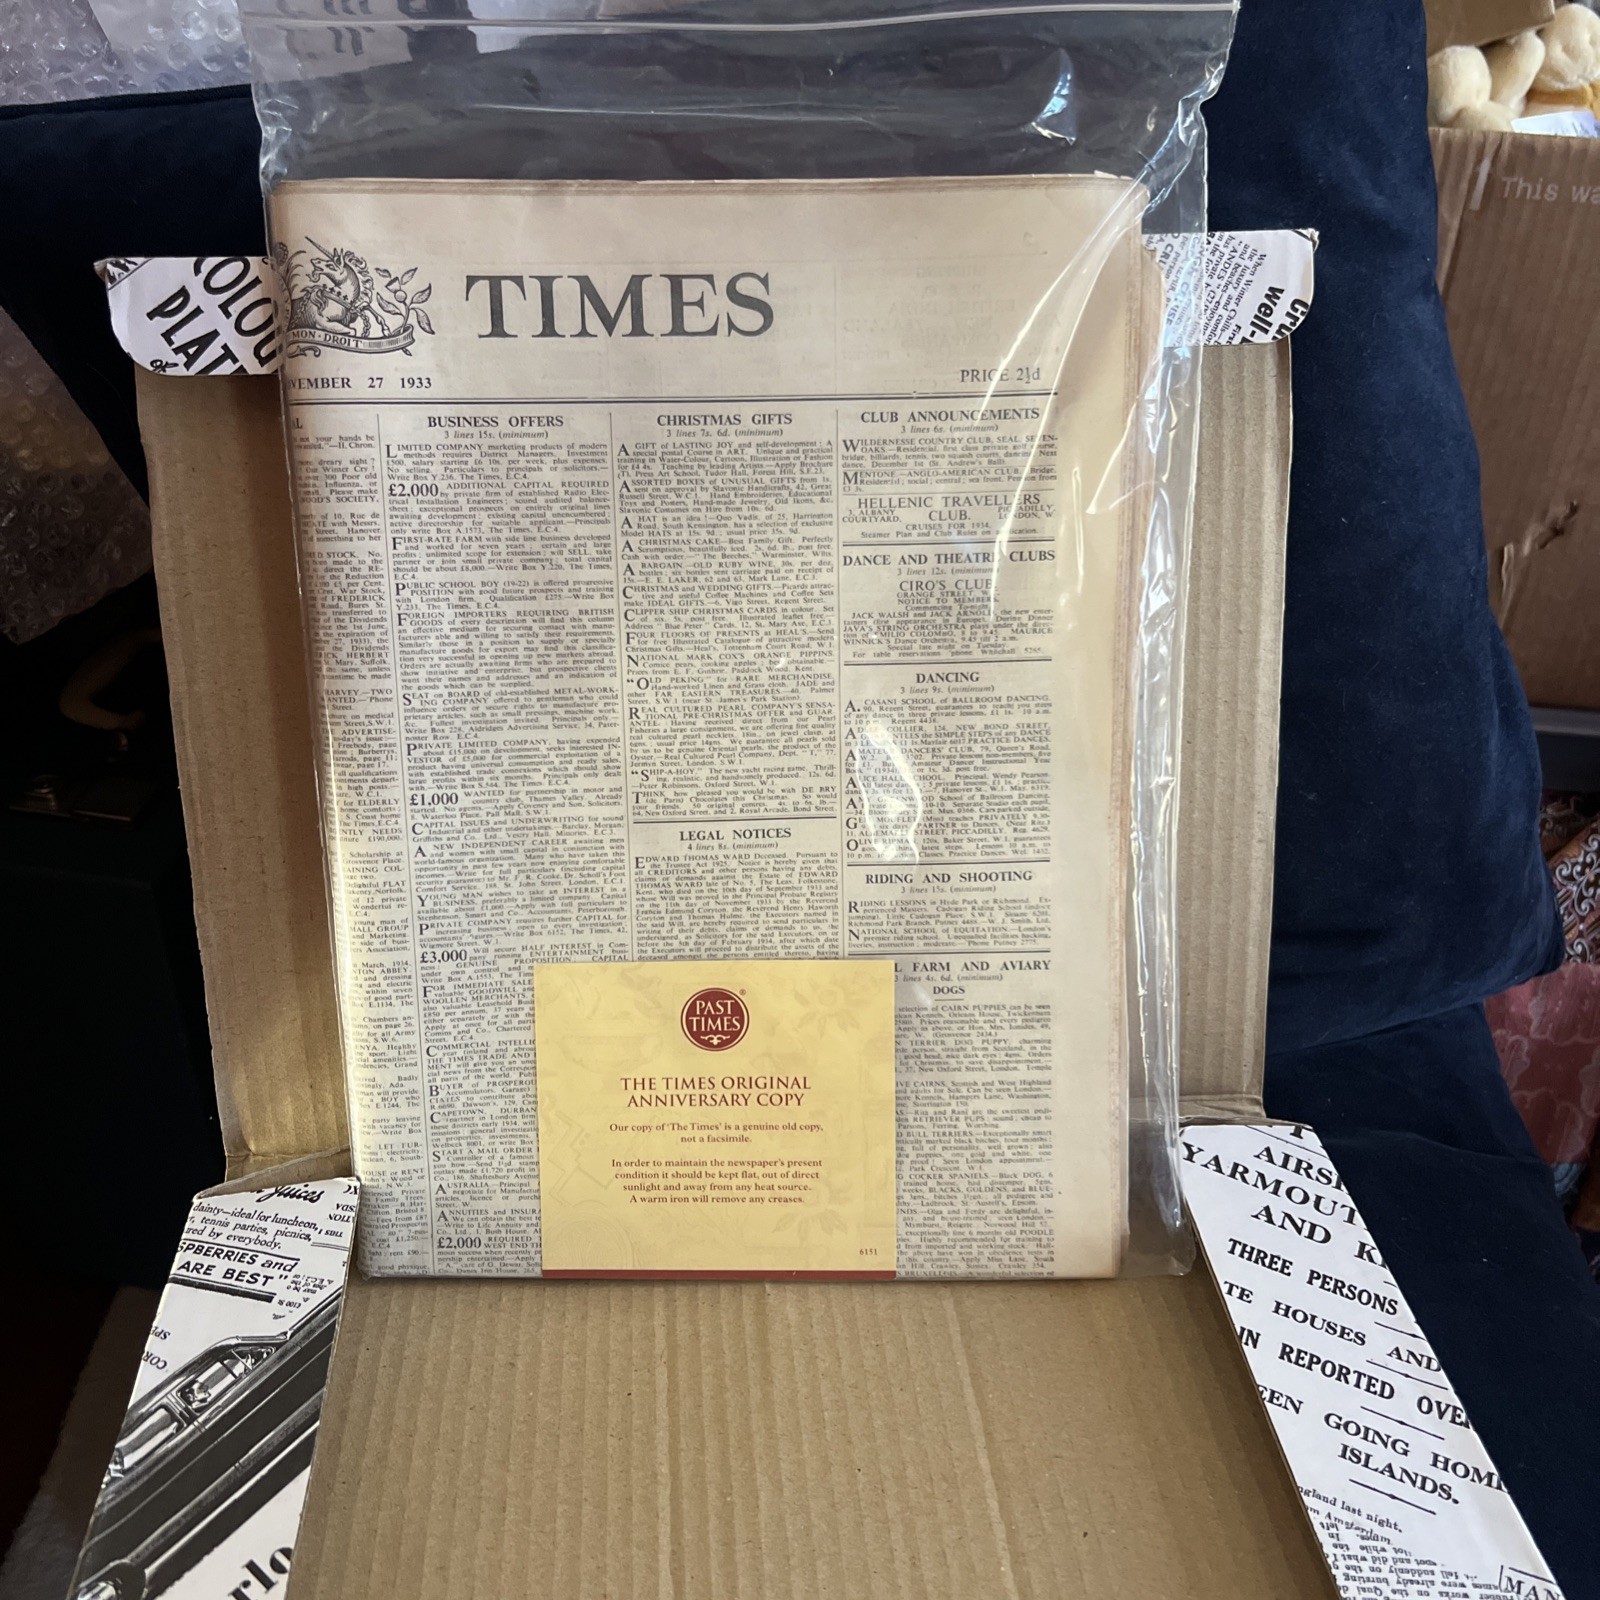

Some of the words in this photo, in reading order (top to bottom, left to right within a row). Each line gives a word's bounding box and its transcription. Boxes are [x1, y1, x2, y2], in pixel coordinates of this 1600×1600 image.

[1502, 177, 1559, 201] This
[1208, 249, 1226, 280] private
[1216, 246, 1238, 281] ANDES
[1252, 254, 1266, 276] When
[1234, 266, 1250, 292] luxury
[1234, 280, 1254, 307] Winter
[466, 271, 775, 339] TIMES
[146, 285, 249, 375] PLAT
[292, 330, 316, 338] MON
[324, 333, 362, 348] DROIT
[368, 376, 384, 389] 27
[400, 376, 432, 389] 1933
[960, 369, 1010, 382] PRICE
[428, 416, 498, 428] BUSINESS
[508, 416, 564, 427] OFFERS
[657, 414, 742, 426] CHRISTMAS
[752, 414, 792, 425] GIFTS
[861, 412, 898, 423] CLUB
[908, 408, 1040, 422] ANNOUNCEMENTS
[498, 430, 549, 440] (minimum)
[700, 429, 712, 437] 7s.
[717, 428, 730, 436] 6d.
[735, 428, 783, 437] (minimum)
[901, 426, 906, 434] 3
[910, 426, 930, 434] lines
[934, 425, 945, 434] 6s.
[950, 424, 998, 434] (minimum)
[386, 444, 432, 458] LIMITED
[488, 444, 526, 452] marketing
[388, 484, 438, 498] £2,000
[858, 496, 933, 509] HELLENIC
[928, 510, 971, 522] CLUB.
[843, 555, 890, 566] DANCE
[898, 554, 928, 565] AND
[1009, 550, 1056, 562] CLUBS
[900, 580, 946, 592] CIRO'S
[916, 672, 980, 684] DANCING
[900, 686, 905, 694] 3
[948, 685, 994, 694] (minimum)
[410, 793, 458, 806] £1,000
[680, 830, 724, 841] LEGAL
[732, 828, 792, 840] NOTICES
[866, 874, 913, 884] RIDING
[922, 873, 950, 883] AND
[959, 871, 1032, 882] SHOOTING
[420, 950, 468, 964] £3,000
[913, 962, 950, 972] FARM
[961, 962, 990, 971] AND
[1000, 960, 1050, 970] AVIARY
[933, 986, 965, 994] DOGS
[696, 1000, 735, 1016] PAST
[689, 1018, 740, 1032] TIMES
[620, 1078, 656, 1091] THE
[662, 1077, 715, 1091] TIMES
[721, 1076, 811, 1090] ORIGINAL
[627, 1094, 752, 1107] ANNIVERSARY
[757, 1094, 805, 1107] COPY
[610, 1123, 628, 1132] Our
[632, 1125, 652, 1134] copy
[655, 1122, 666, 1132] of
[724, 1122, 732, 1132] is
[742, 1122, 779, 1133] genuine
[782, 1122, 797, 1131] old
[799, 1125, 824, 1133] copy,
[681, 1135, 696, 1143] not
[707, 1134, 752, 1143] facsimile.
[612, 1160, 620, 1168] In
[623, 1159, 650, 1168] order
[665, 1159, 707, 1168] maintain
[710, 1159, 724, 1168] the
[728, 1159, 785, 1170] newspaper's
[788, 1160, 822, 1170] present
[615, 1171, 659, 1180] condition
[662, 1171, 668, 1179] it
[671, 1170, 702, 1179] should
[705, 1170, 716, 1179] be
[718, 1171, 738, 1181] kept
[741, 1170, 760, 1180] flat,
[780, 1170, 791, 1179] of
[792, 1170, 820, 1179] direct
[624, 1182, 660, 1193] sunlight
[664, 1183, 681, 1191] and
[684, 1184, 707, 1193] away
[710, 1183, 733, 1191] from
[736, 1185, 752, 1193] any
[754, 1183, 775, 1191] heat
[1182, 1142, 1368, 1230] YARMOUT
[630, 1195, 637, 1203] A
[670, 1195, 689, 1203] iron
[692, 1194, 708, 1203] will
[749, 1197, 764, 1205] any
[256, 1209, 271, 1222] for
[271, 1214, 318, 1231] luncheon,
[1251, 1205, 1331, 1244] AND
[200, 1217, 230, 1228] tennis
[233, 1222, 268, 1235] parties,
[274, 1227, 312, 1242] picnics,
[208, 1228, 222, 1240] by
[227, 1233, 282, 1249] everybody.
[437, 1237, 482, 1250] £2,000
[178, 1260, 216, 1276] ARE
[261, 1260, 298, 1272] and
[1228, 1238, 1293, 1276] THREE
[1306, 1269, 1398, 1315] PERSONS
[1272, 1301, 1366, 1346] HOUSES
[1387, 1346, 1441, 1372] AND
[1278, 1343, 1394, 1400] REPORTED
[1324, 1413, 1410, 1456] GOING
[1338, 1444, 1459, 1504] ISLANDS.
[1341, 1502, 1362, 1516] last
[1366, 1509, 1402, 1533] night.
